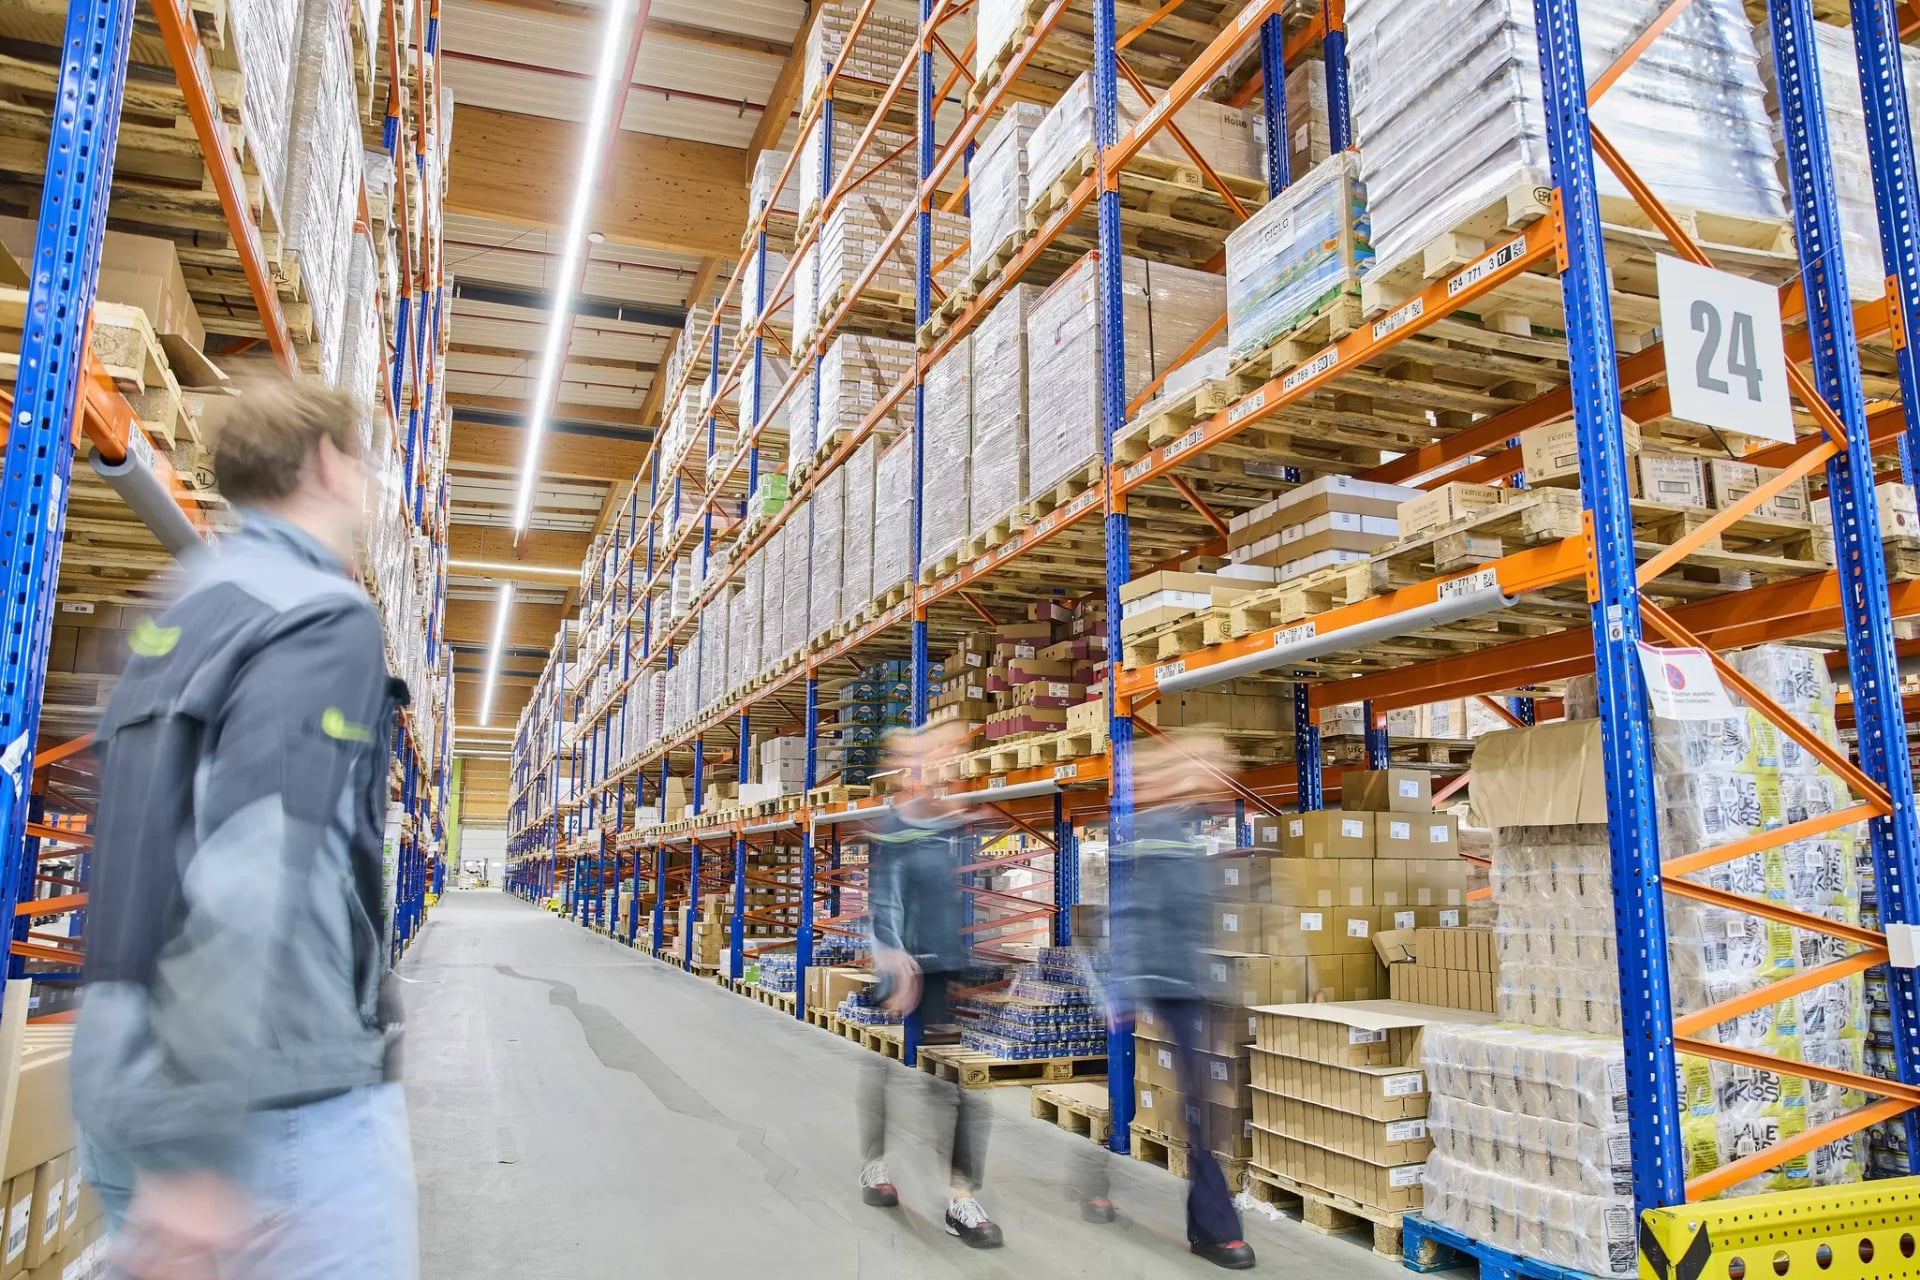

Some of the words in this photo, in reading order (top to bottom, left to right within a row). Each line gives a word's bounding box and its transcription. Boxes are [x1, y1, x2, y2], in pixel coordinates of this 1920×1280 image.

[1224, 114, 1248, 129] Holle
[1690, 299, 1763, 404] 24
[196, 472, 210, 485] AL
